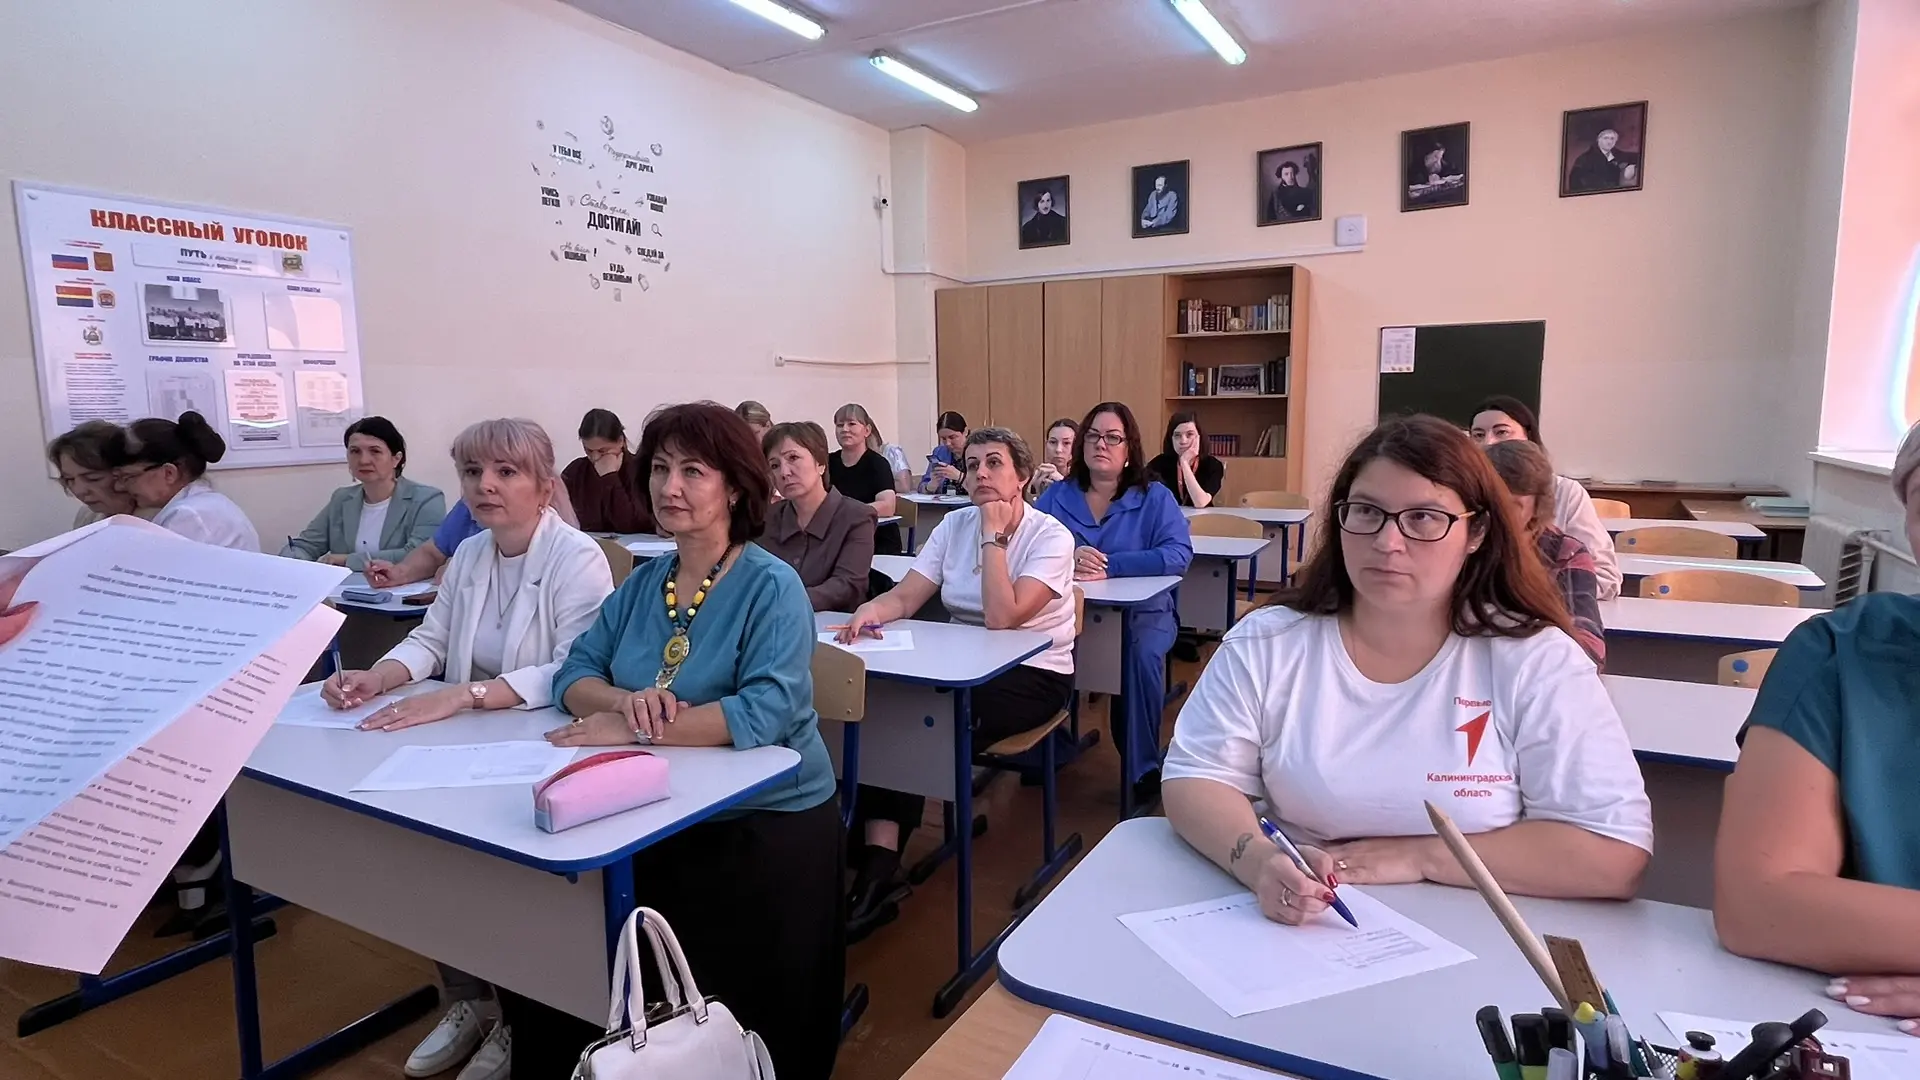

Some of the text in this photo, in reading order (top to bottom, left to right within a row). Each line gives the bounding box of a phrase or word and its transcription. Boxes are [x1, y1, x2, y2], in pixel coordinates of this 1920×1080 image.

[89, 208, 309, 251] КЛАССНЫЙ УГОЛОК
[587, 210, 641, 237] ДОСТИГАЙ!
[180, 248, 207, 259] ПУТЬ
[1453, 696, 1492, 708] Первые
[1453, 788, 1492, 797] область
